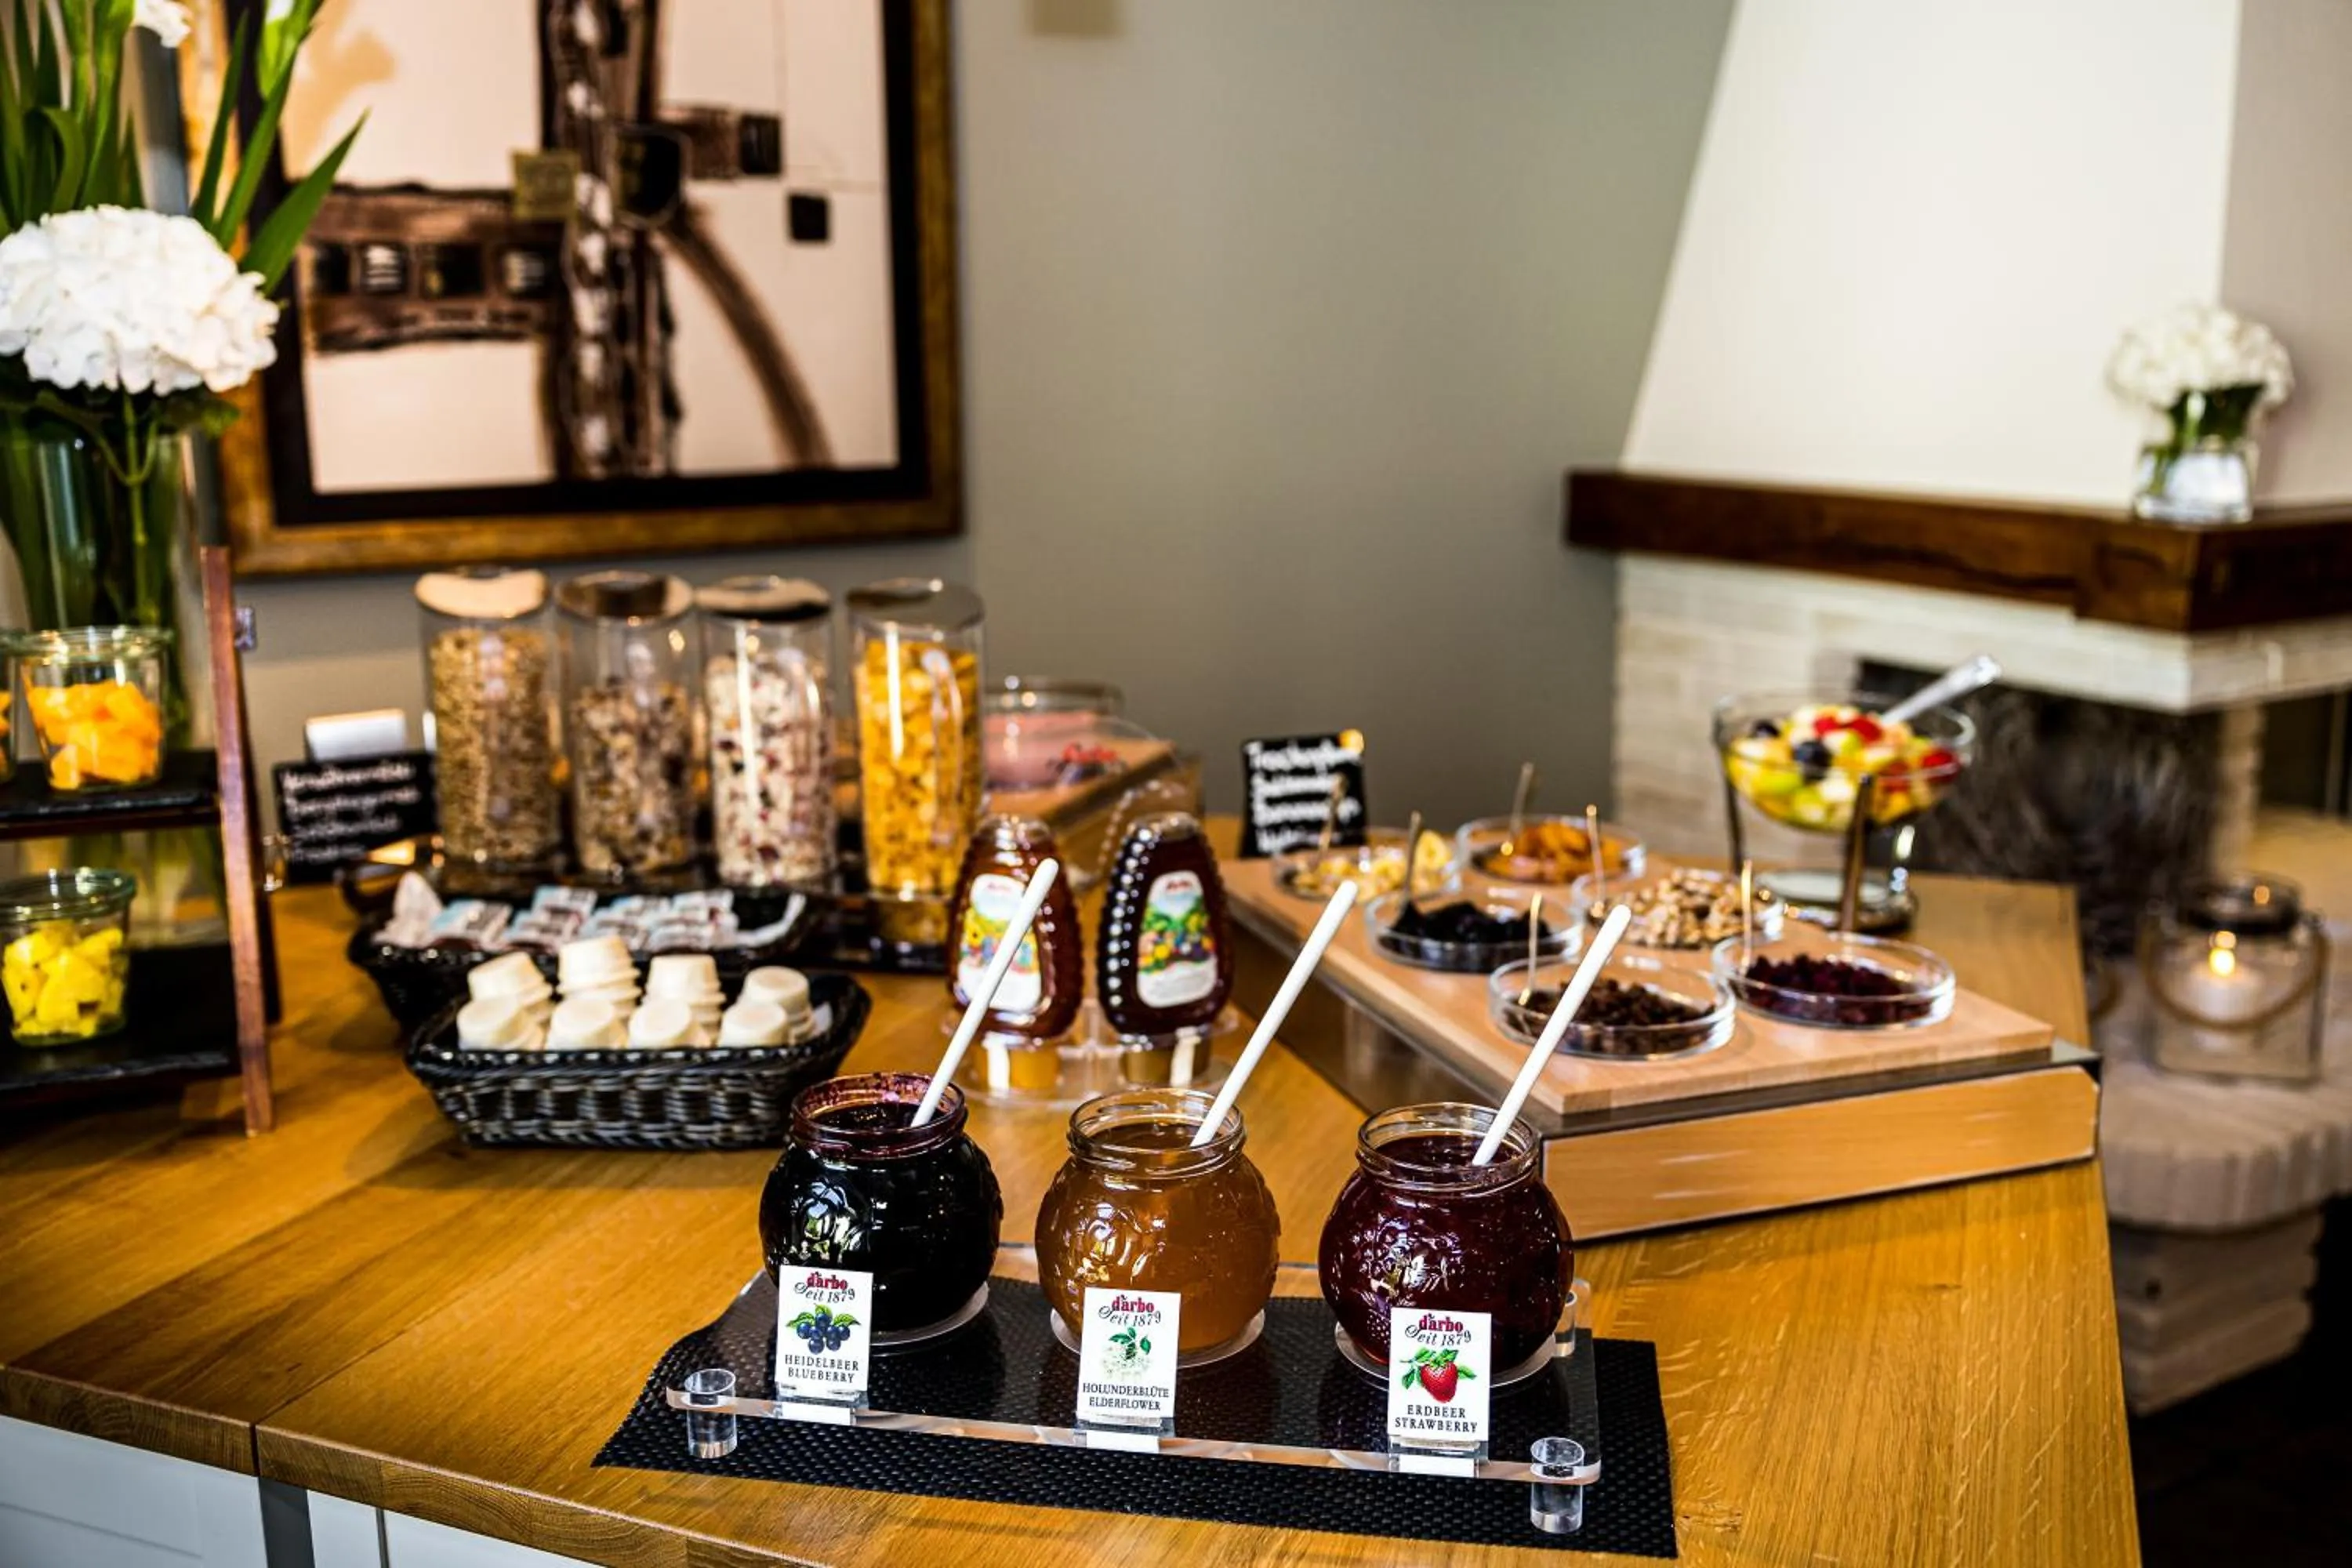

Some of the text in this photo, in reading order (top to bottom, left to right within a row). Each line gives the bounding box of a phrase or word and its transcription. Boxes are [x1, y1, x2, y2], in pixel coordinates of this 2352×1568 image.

[793, 1281, 855, 1304] Seit 1879
[1098, 1305, 1161, 1327] Seit 1879
[1405, 1324, 1472, 1347] Seit 1879
[785, 1355, 859, 1371] HEIDELBEER
[788, 1368, 855, 1384] BLUEBERRY
[1083, 1382, 1170, 1398] HOLUNDERBLÜTE
[1089, 1396, 1161, 1411] ELDERFLOWER
[1407, 1404, 1466, 1418] ERDBEER
[1395, 1417, 1478, 1434] STRAWBERRY
